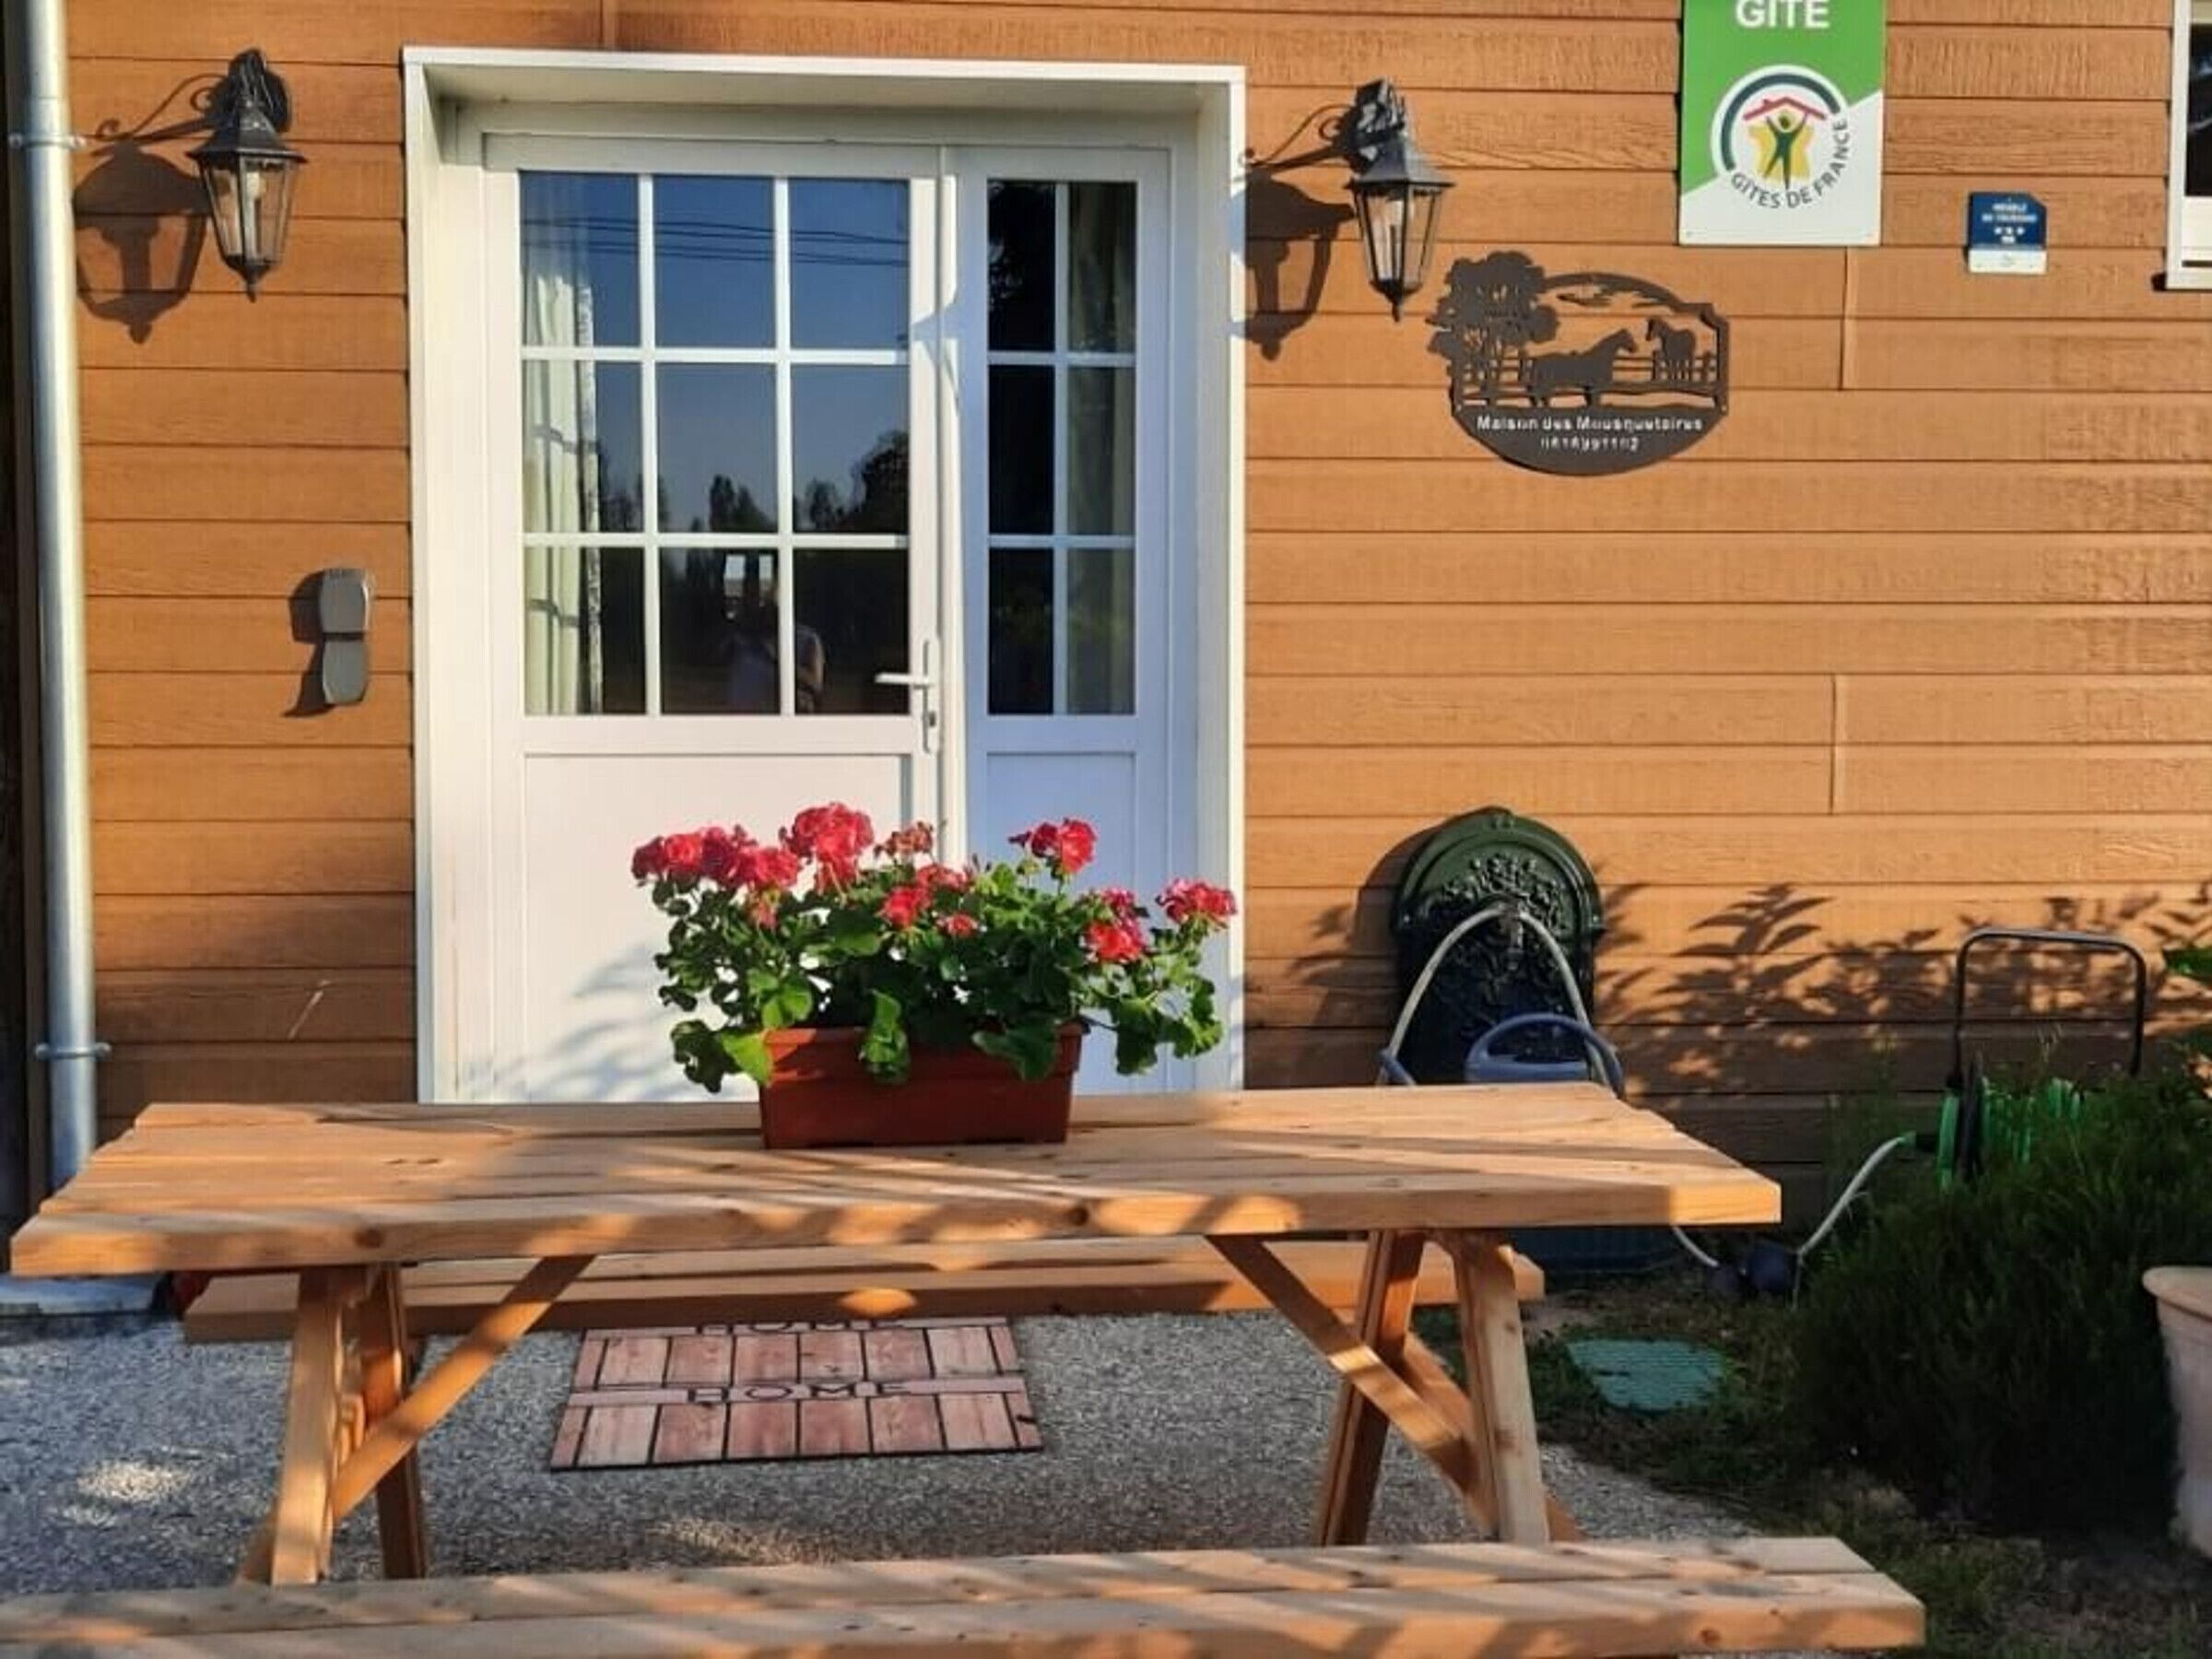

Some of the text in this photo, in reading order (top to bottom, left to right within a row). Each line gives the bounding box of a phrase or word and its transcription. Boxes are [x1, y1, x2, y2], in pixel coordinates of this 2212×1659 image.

[1786, 186, 1813, 208] DE
[1813, 119, 1851, 196] FRANCE
[1477, 415, 1702, 433] Maison des Mousquetaires
[688, 1382, 916, 1403] HOME
